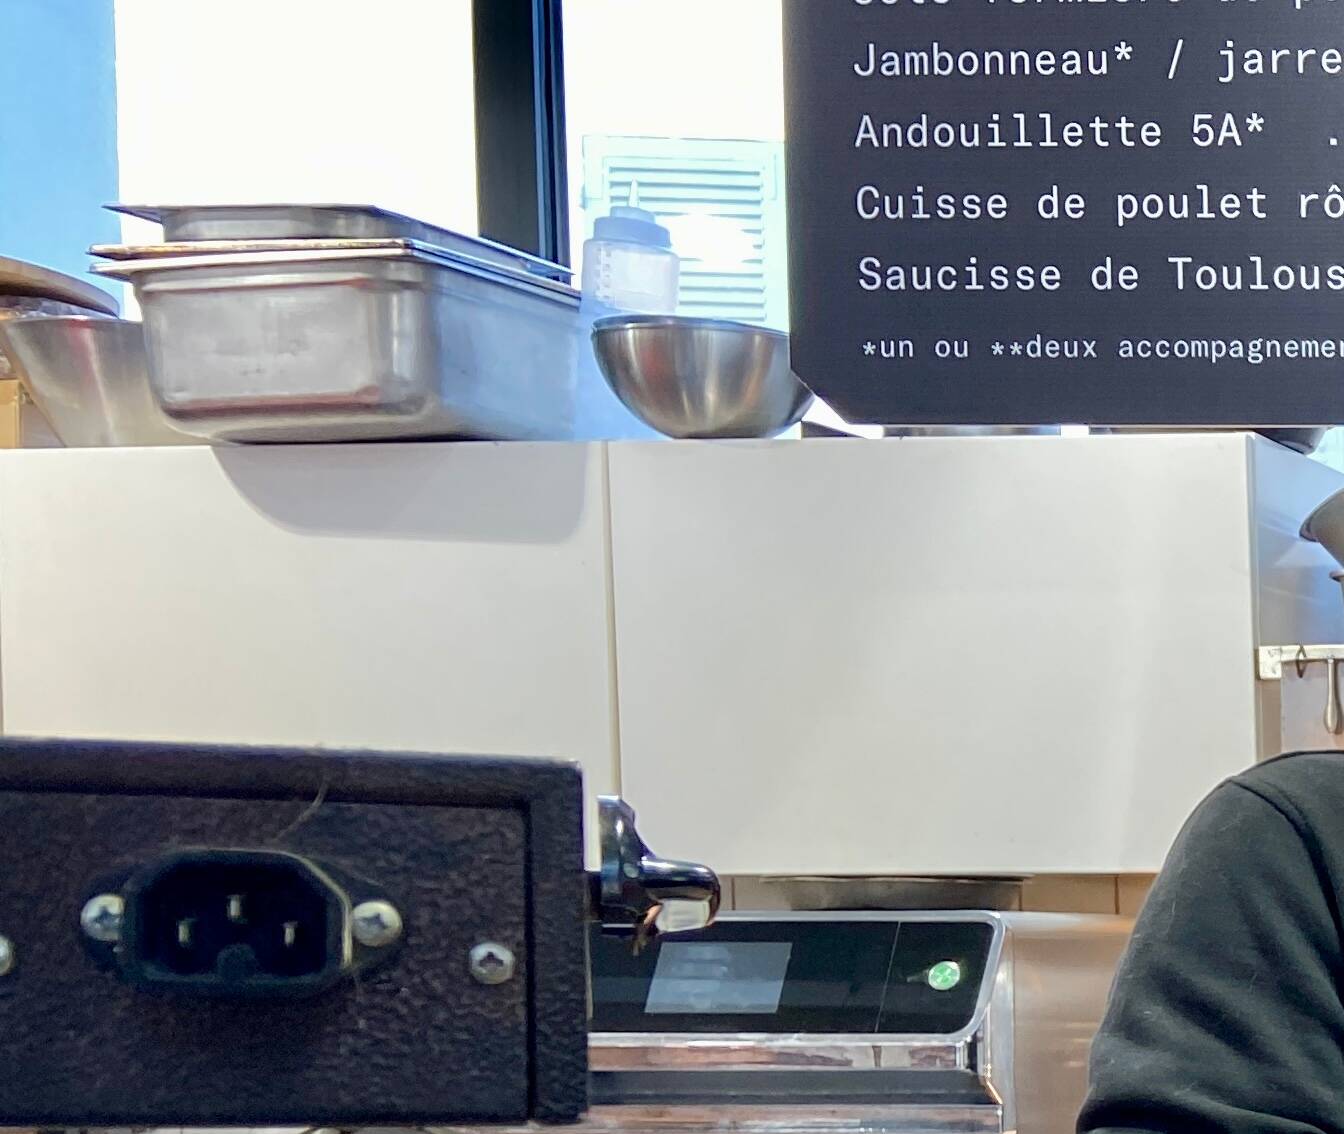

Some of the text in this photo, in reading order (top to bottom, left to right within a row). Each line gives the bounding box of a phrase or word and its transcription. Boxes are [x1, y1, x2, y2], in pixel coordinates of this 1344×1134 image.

[855, 113, 1162, 148] Andouillette
[856, 185, 1008, 220] Cuisse
[1037, 184, 1085, 219] de
[1117, 184, 1267, 227] poulet
[858, 256, 1061, 291] Saucisse
[1091, 256, 1139, 291] de
[934, 340, 969, 358] ou
